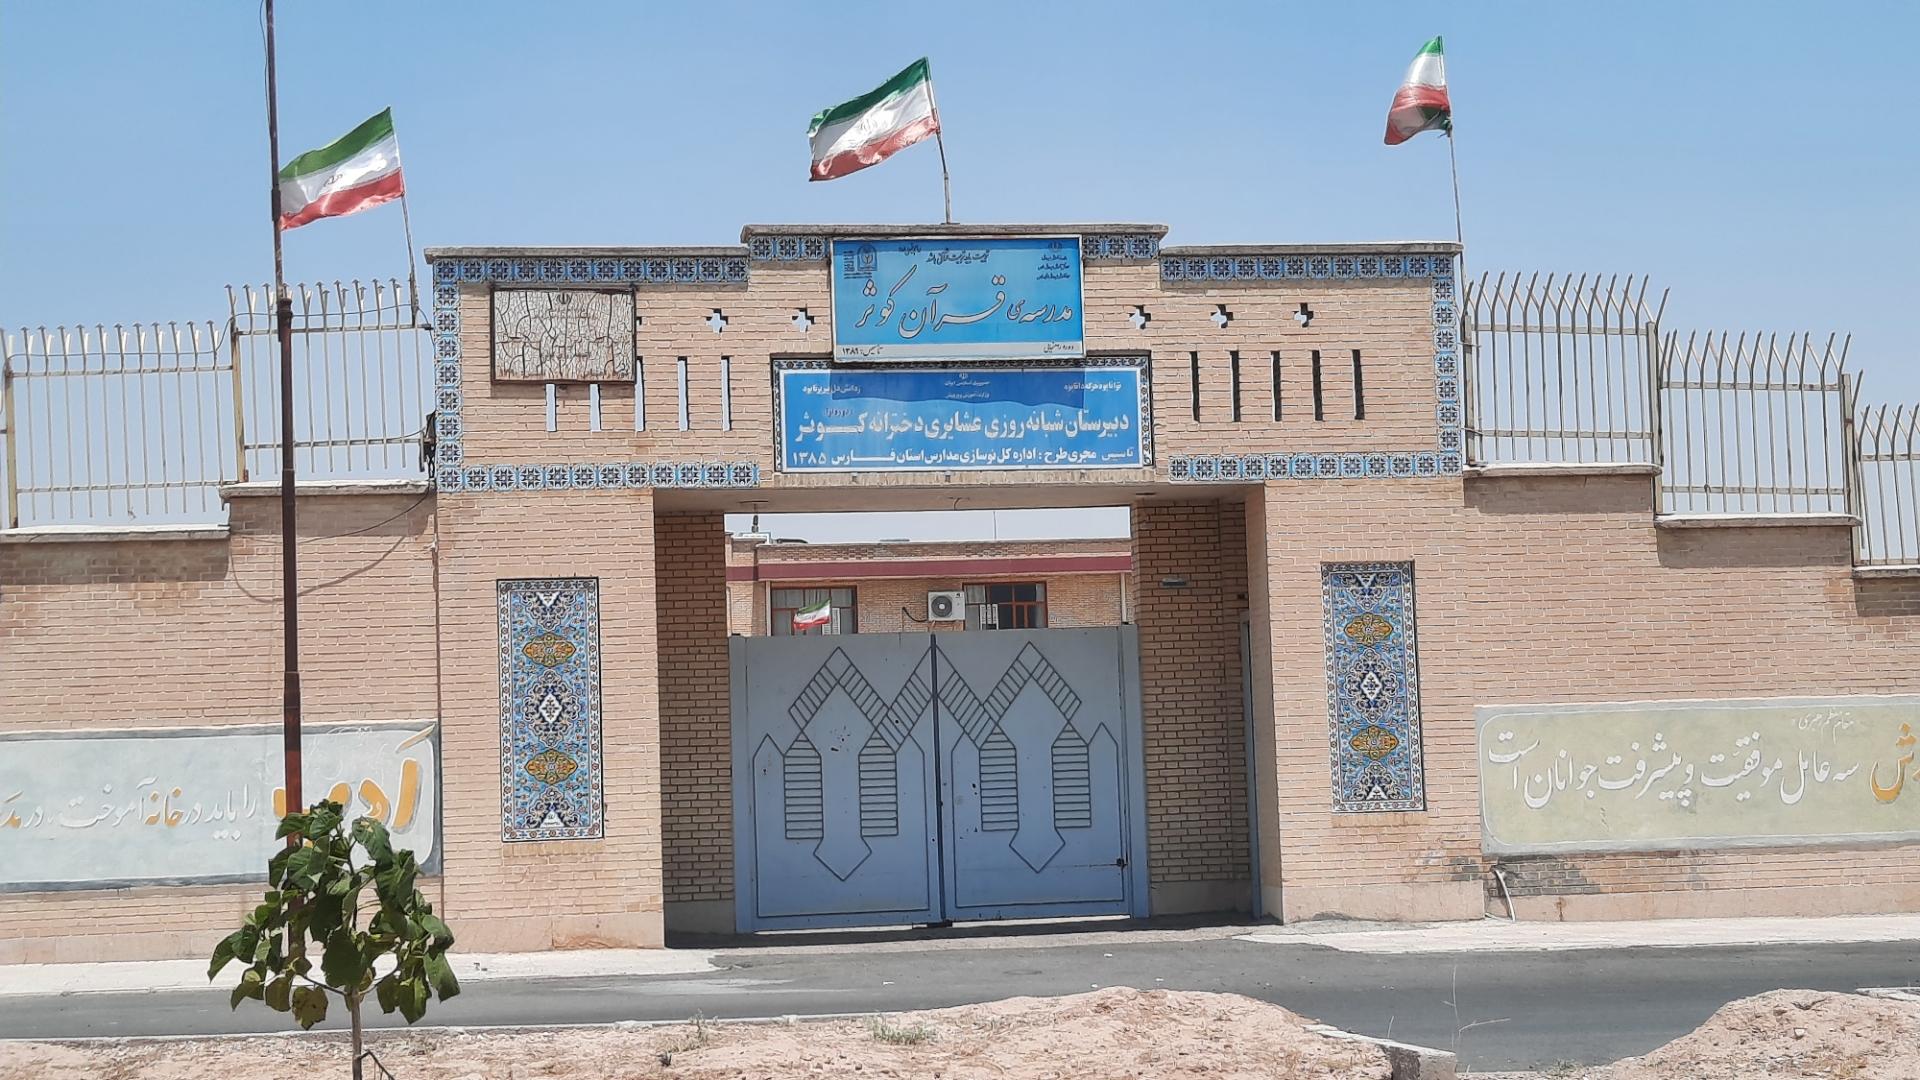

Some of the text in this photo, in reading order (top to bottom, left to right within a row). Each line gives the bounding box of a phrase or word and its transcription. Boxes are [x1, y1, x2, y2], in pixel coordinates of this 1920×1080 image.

[855, 264, 918, 328] کوثر
[897, 274, 1006, 339] قرآن
[794, 409, 1130, 442] دبیرستان شبانه روزی عشایری دخترانه کوثر
[793, 451, 828, 466] ۱۳۸۵
[830, 447, 896, 466] فارس
[896, 447, 925, 464] استان
[924, 447, 960, 464] مدارس
[959, 446, 997, 464] نوسازی
[997, 446, 1013, 463] کل
[1012, 446, 1037, 460] اداره
[1067, 448, 1097, 463] مجری
[1488, 731, 1541, 791] است
[1598, 732, 1693, 807] پیشرفت
[1833, 762, 1860, 782] سه
[1523, 749, 1598, 809] جوانان
[1683, 763, 1695, 786] و
[1780, 749, 1832, 805] عامل
[144, 785, 185, 828] خانه
[184, 801, 204, 825] در
[243, 783, 258, 819] را
[23, 805, 45, 829] در
[205, 790, 242, 840] باید
